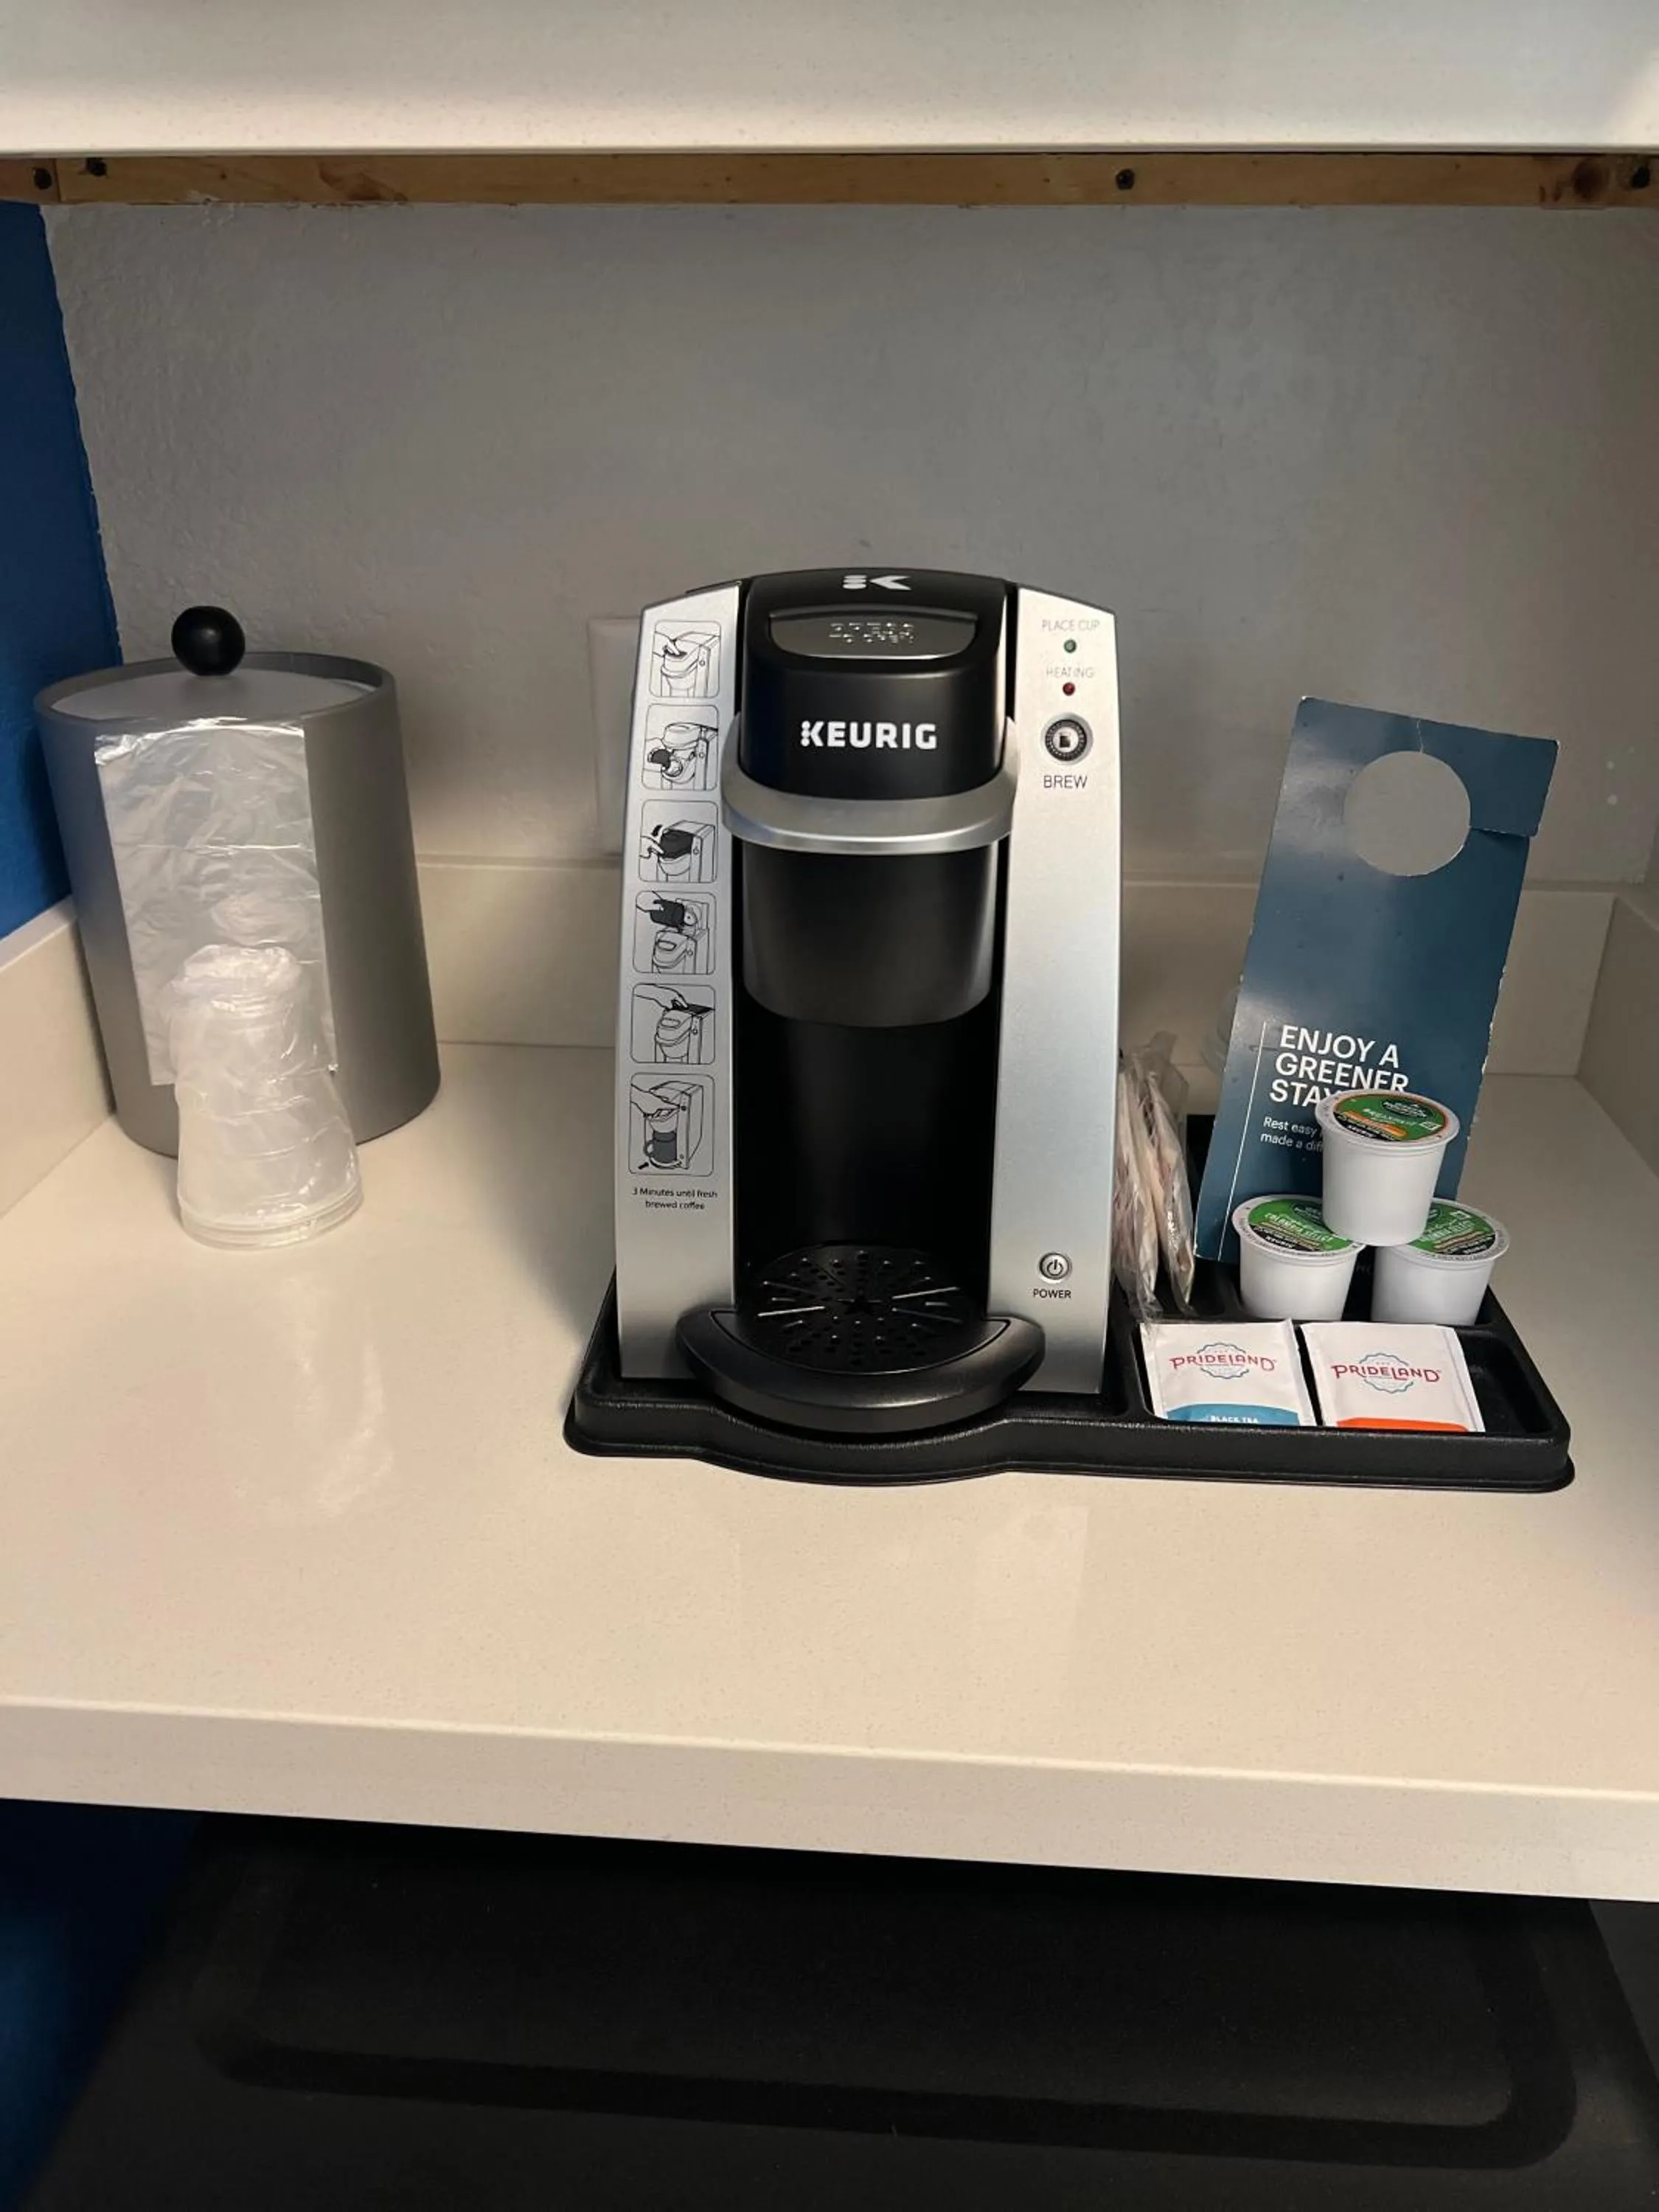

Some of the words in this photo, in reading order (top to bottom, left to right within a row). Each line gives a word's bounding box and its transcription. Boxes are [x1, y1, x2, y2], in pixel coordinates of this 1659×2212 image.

[1042, 619, 1074, 632] PLACE
[1078, 619, 1100, 632] CUP
[1046, 666, 1095, 678] HEATING
[801, 720, 937, 749] KEURIG
[1043, 775, 1088, 789] BREW
[1280, 1025, 1376, 1062] ENJOY
[1378, 1044, 1399, 1068] A
[1275, 1052, 1410, 1092] GREENER
[1263, 1116, 1289, 1131] Rest
[1291, 1124, 1318, 1138] easy
[1260, 1133, 1293, 1147] made
[1295, 1140, 1304, 1149] a
[1169, 1354, 1276, 1371] PRIDELAND
[1331, 1365, 1440, 1382] PRIDELAND
